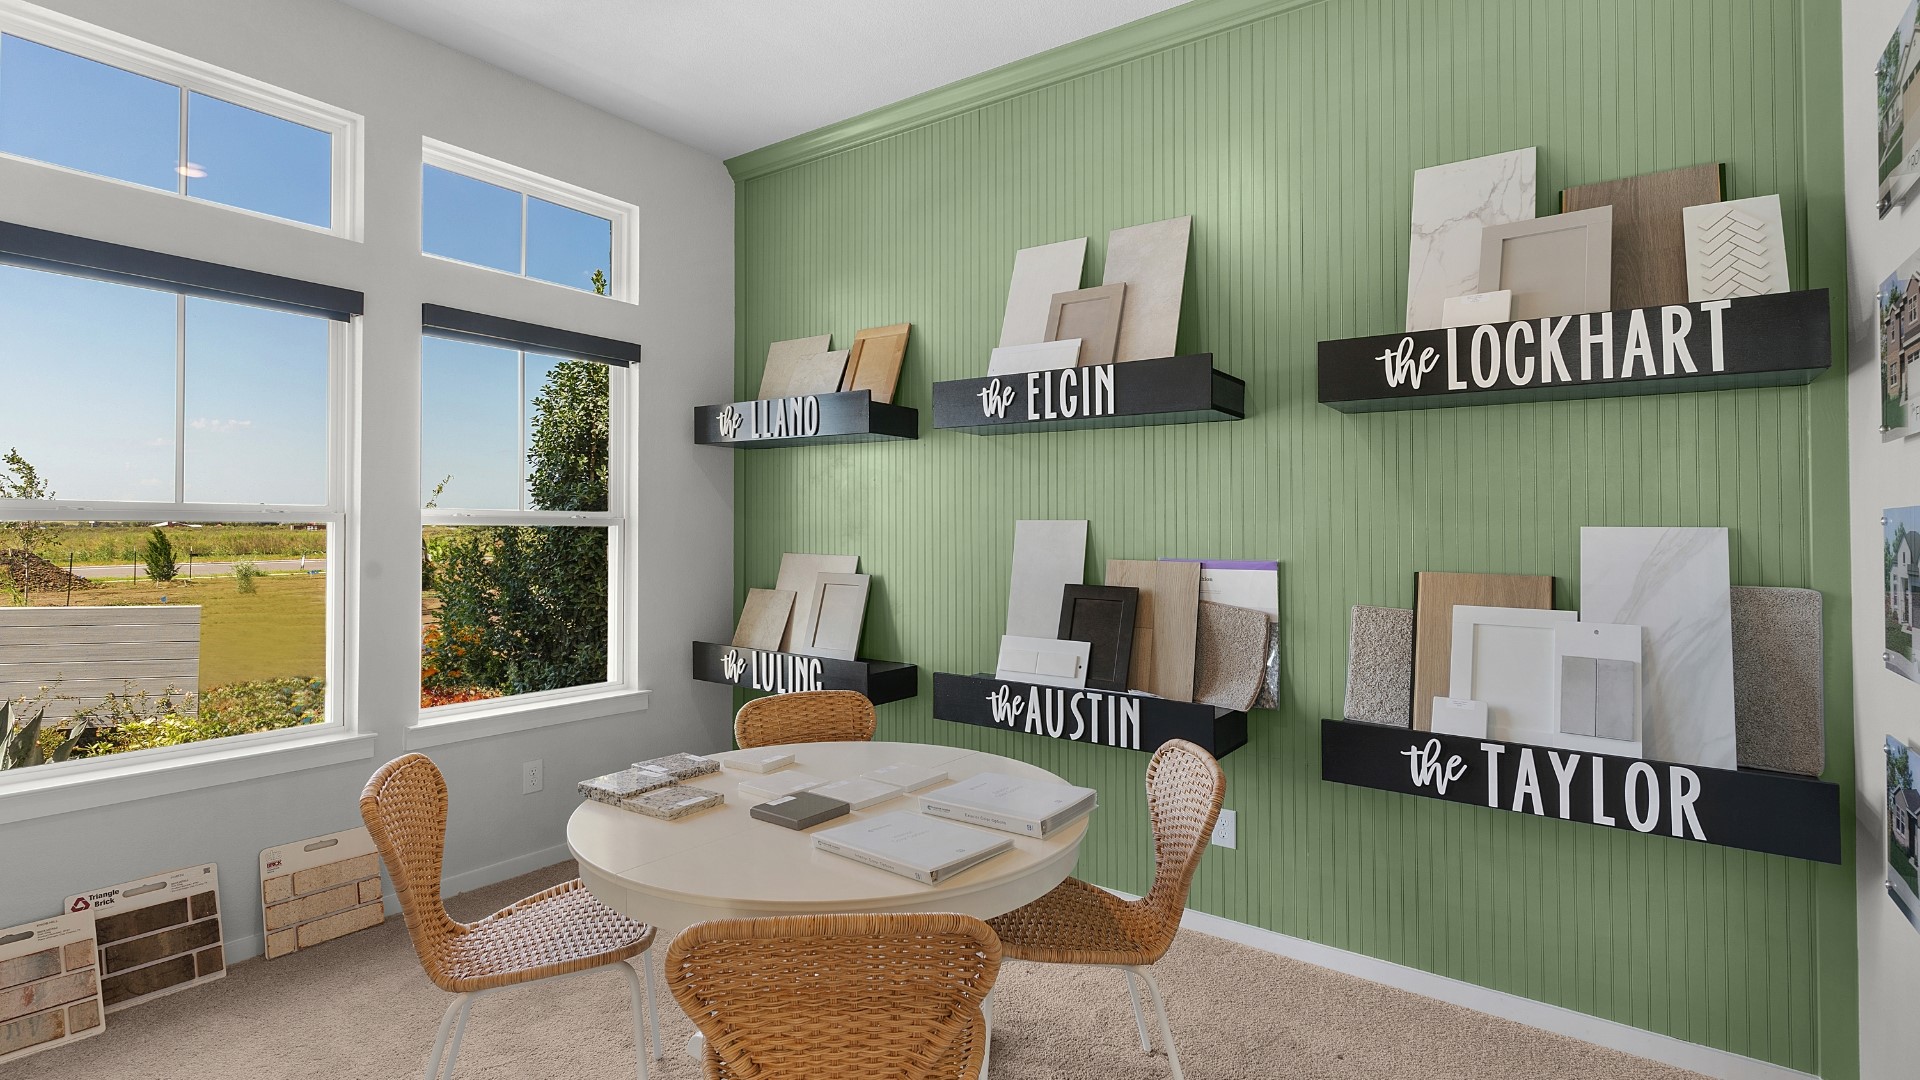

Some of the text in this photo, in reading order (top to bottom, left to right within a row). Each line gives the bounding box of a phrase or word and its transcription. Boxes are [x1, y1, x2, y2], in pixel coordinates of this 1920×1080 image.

[1375, 299, 1732, 392] the LOCKHART
[716, 395, 820, 439] the LLANO
[976, 364, 1115, 421] the ELGIN
[719, 649, 823, 695] the LULING
[985, 684, 1141, 750] the AUSTIN
[1401, 738, 1708, 842] the TAYLOR
[88, 889, 120, 901] Triangle
[94, 897, 116, 908] Brick
